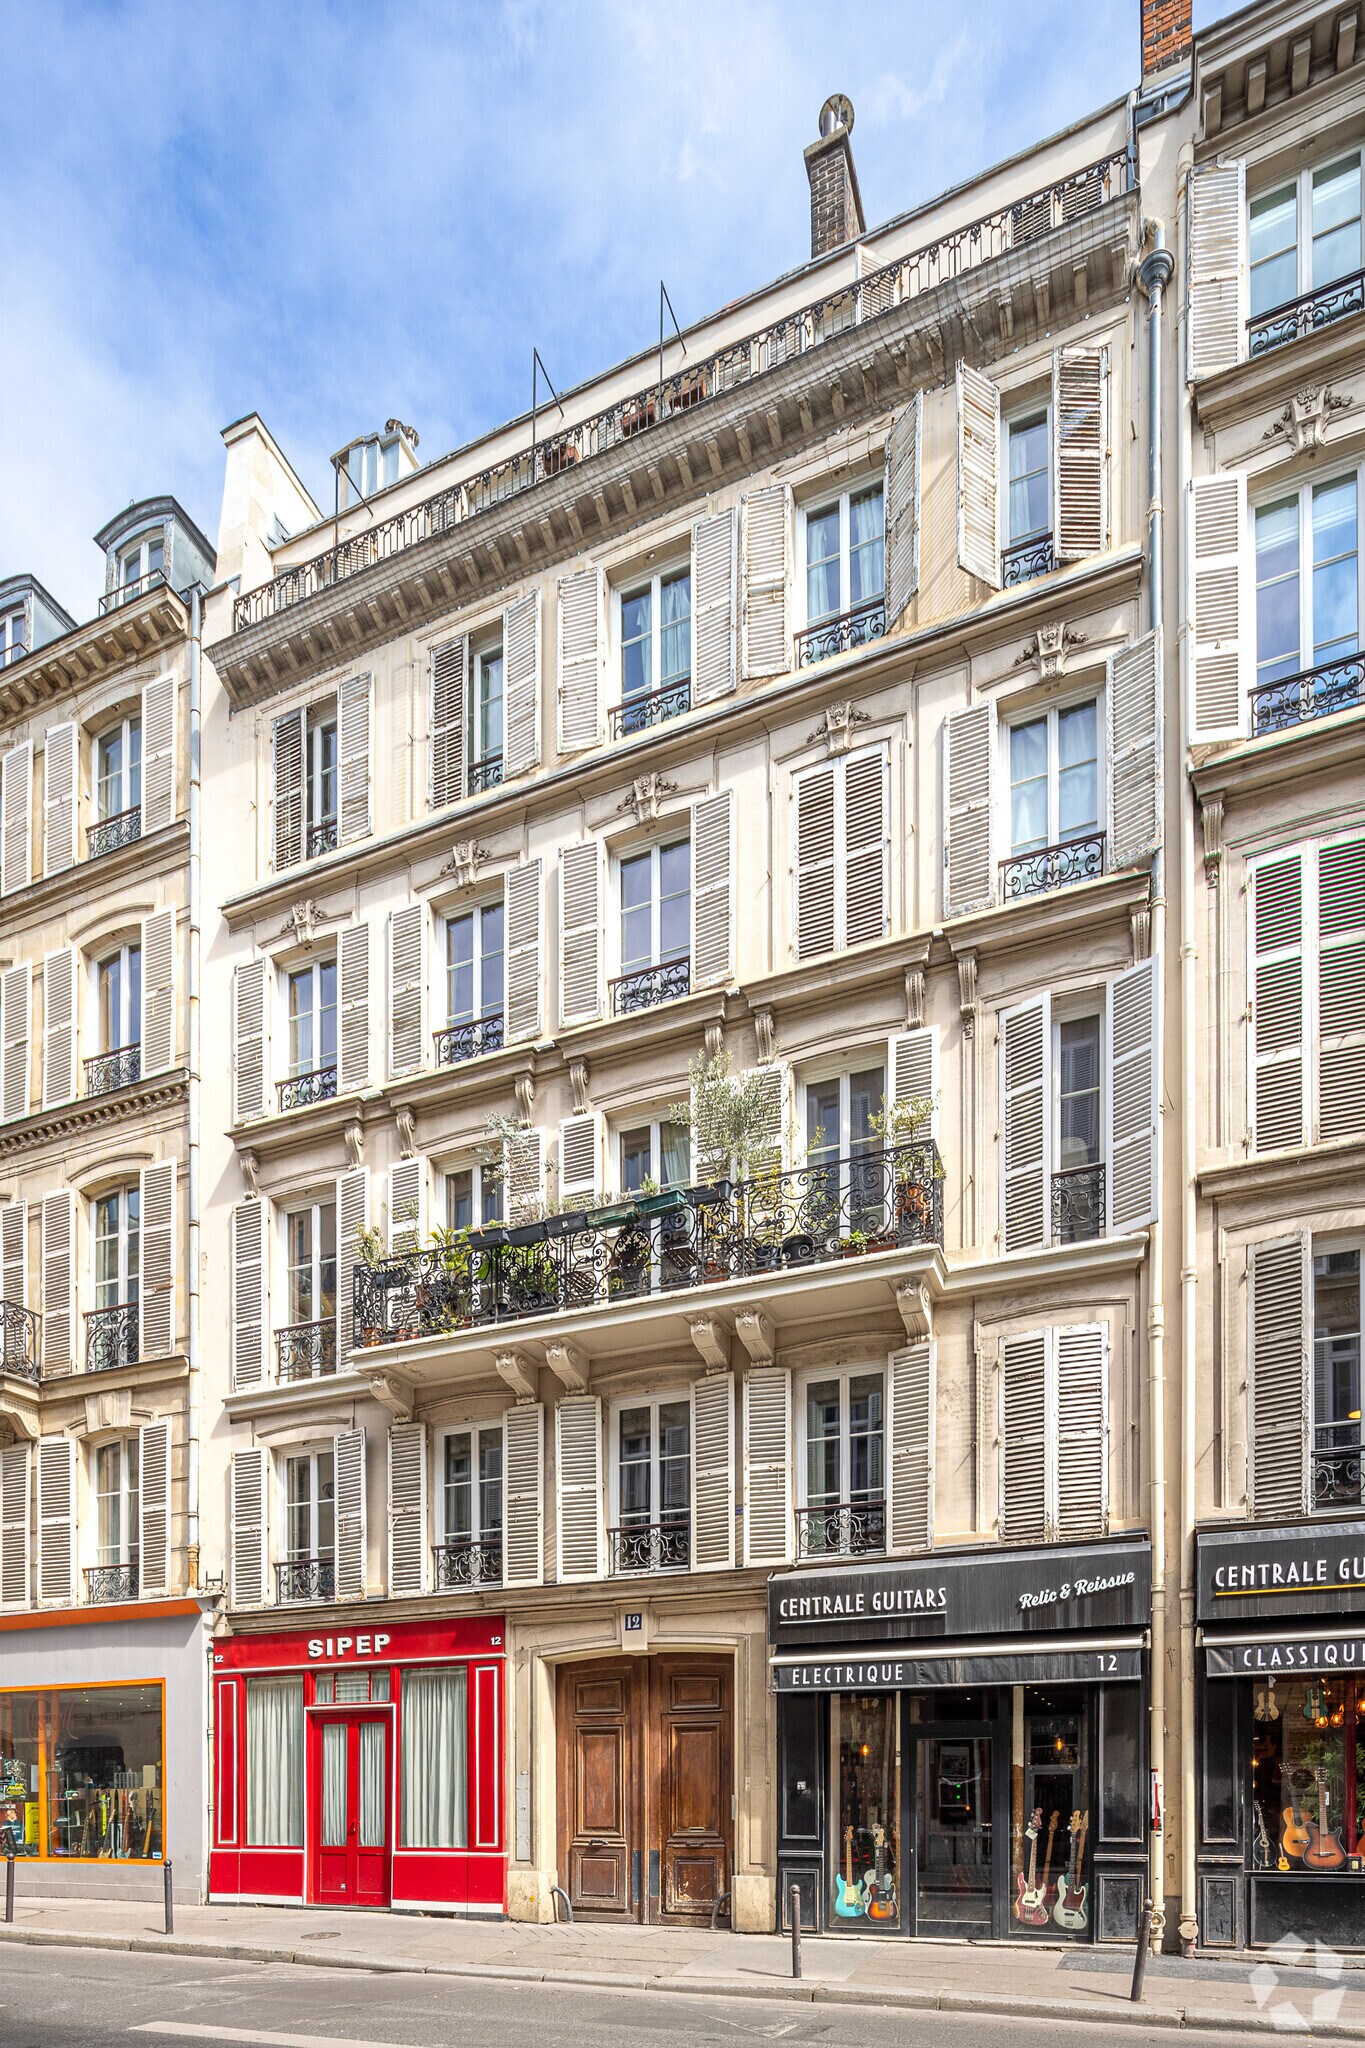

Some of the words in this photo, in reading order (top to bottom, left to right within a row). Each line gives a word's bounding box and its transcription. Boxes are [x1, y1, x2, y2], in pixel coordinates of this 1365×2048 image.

[1215, 1559, 1327, 1587] CENTRALE
[1018, 1589, 1057, 1610] Relic
[1060, 1583, 1071, 1599] &
[1073, 1571, 1135, 1596] Reissue
[779, 1593, 864, 1618] CENTRALE
[872, 1587, 947, 1611] GUITARS
[627, 1615, 640, 1629] 12
[308, 1634, 391, 1658] SIPEP
[491, 1636, 502, 1646] 12
[214, 1654, 224, 1663] 12
[1096, 1654, 1118, 1672] 12
[1243, 1643, 1365, 1667] CLASSIQU
[792, 1663, 904, 1685] ELECTRIQUE
